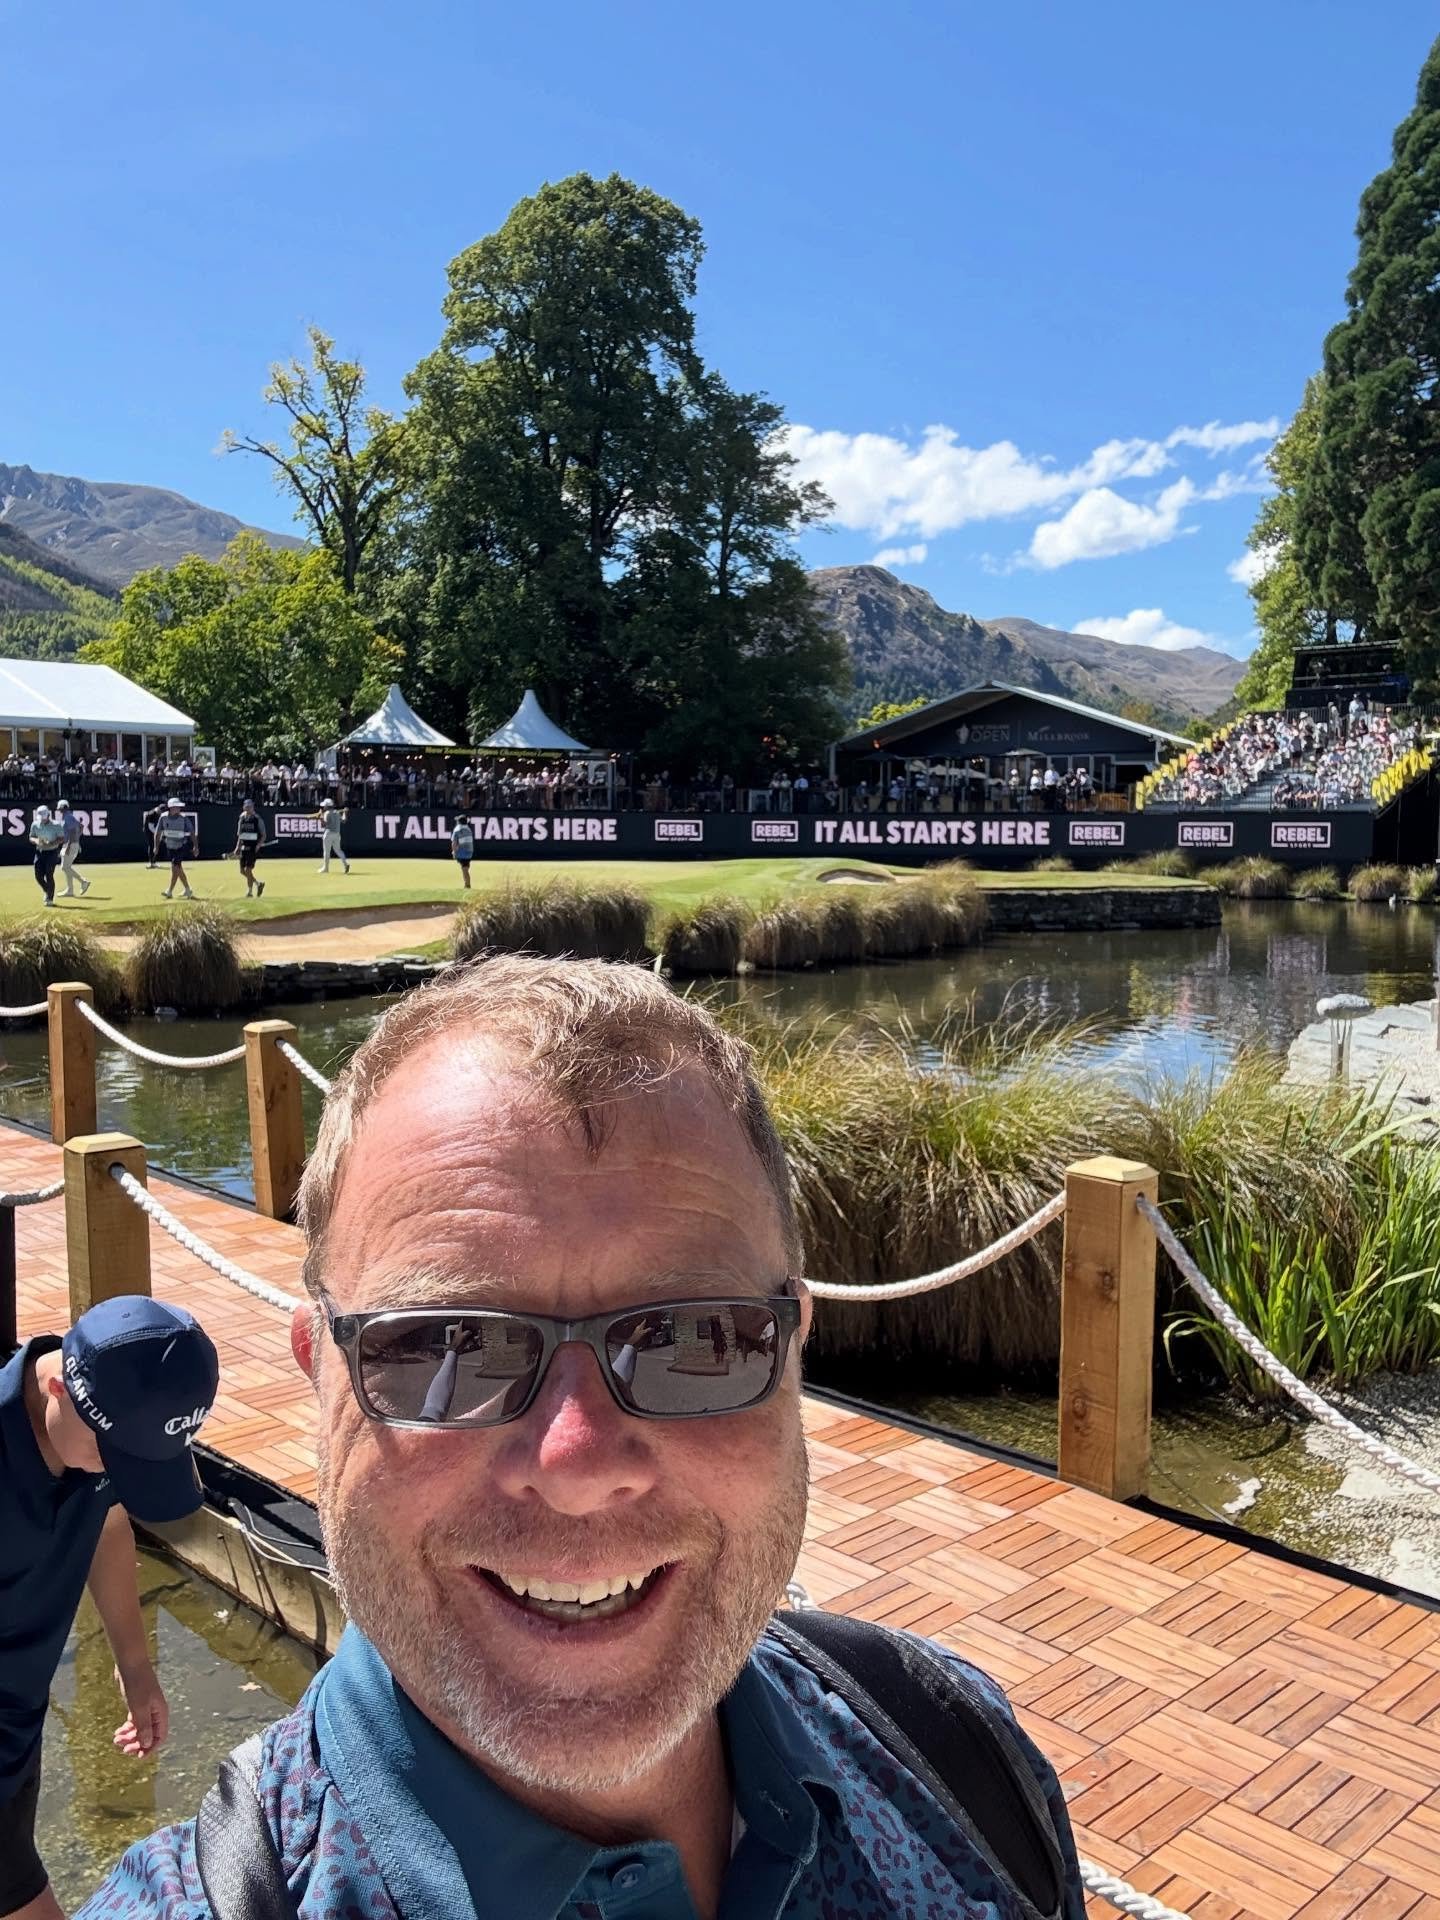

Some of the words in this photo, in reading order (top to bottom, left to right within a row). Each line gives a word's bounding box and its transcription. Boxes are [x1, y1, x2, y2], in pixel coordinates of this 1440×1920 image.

[971, 730, 1010, 742] OPEN
[280, 818, 325, 832] REBEL
[375, 815, 400, 839] IT
[404, 816, 452, 839] ALL
[467, 816, 548, 841] TARTS
[553, 818, 617, 841] HERE
[659, 824, 698, 837] REBEL
[756, 825, 794, 837] REBEL
[815, 820, 838, 843] IT
[840, 821, 882, 843] ALL
[886, 820, 977, 845] STARTS
[982, 821, 1050, 845] HERE
[1074, 827, 1119, 840] REBEL
[1183, 827, 1228, 841] REBEL
[1277, 828, 1325, 842] REBEL
[65, 1355, 113, 1431] QUANTUM
